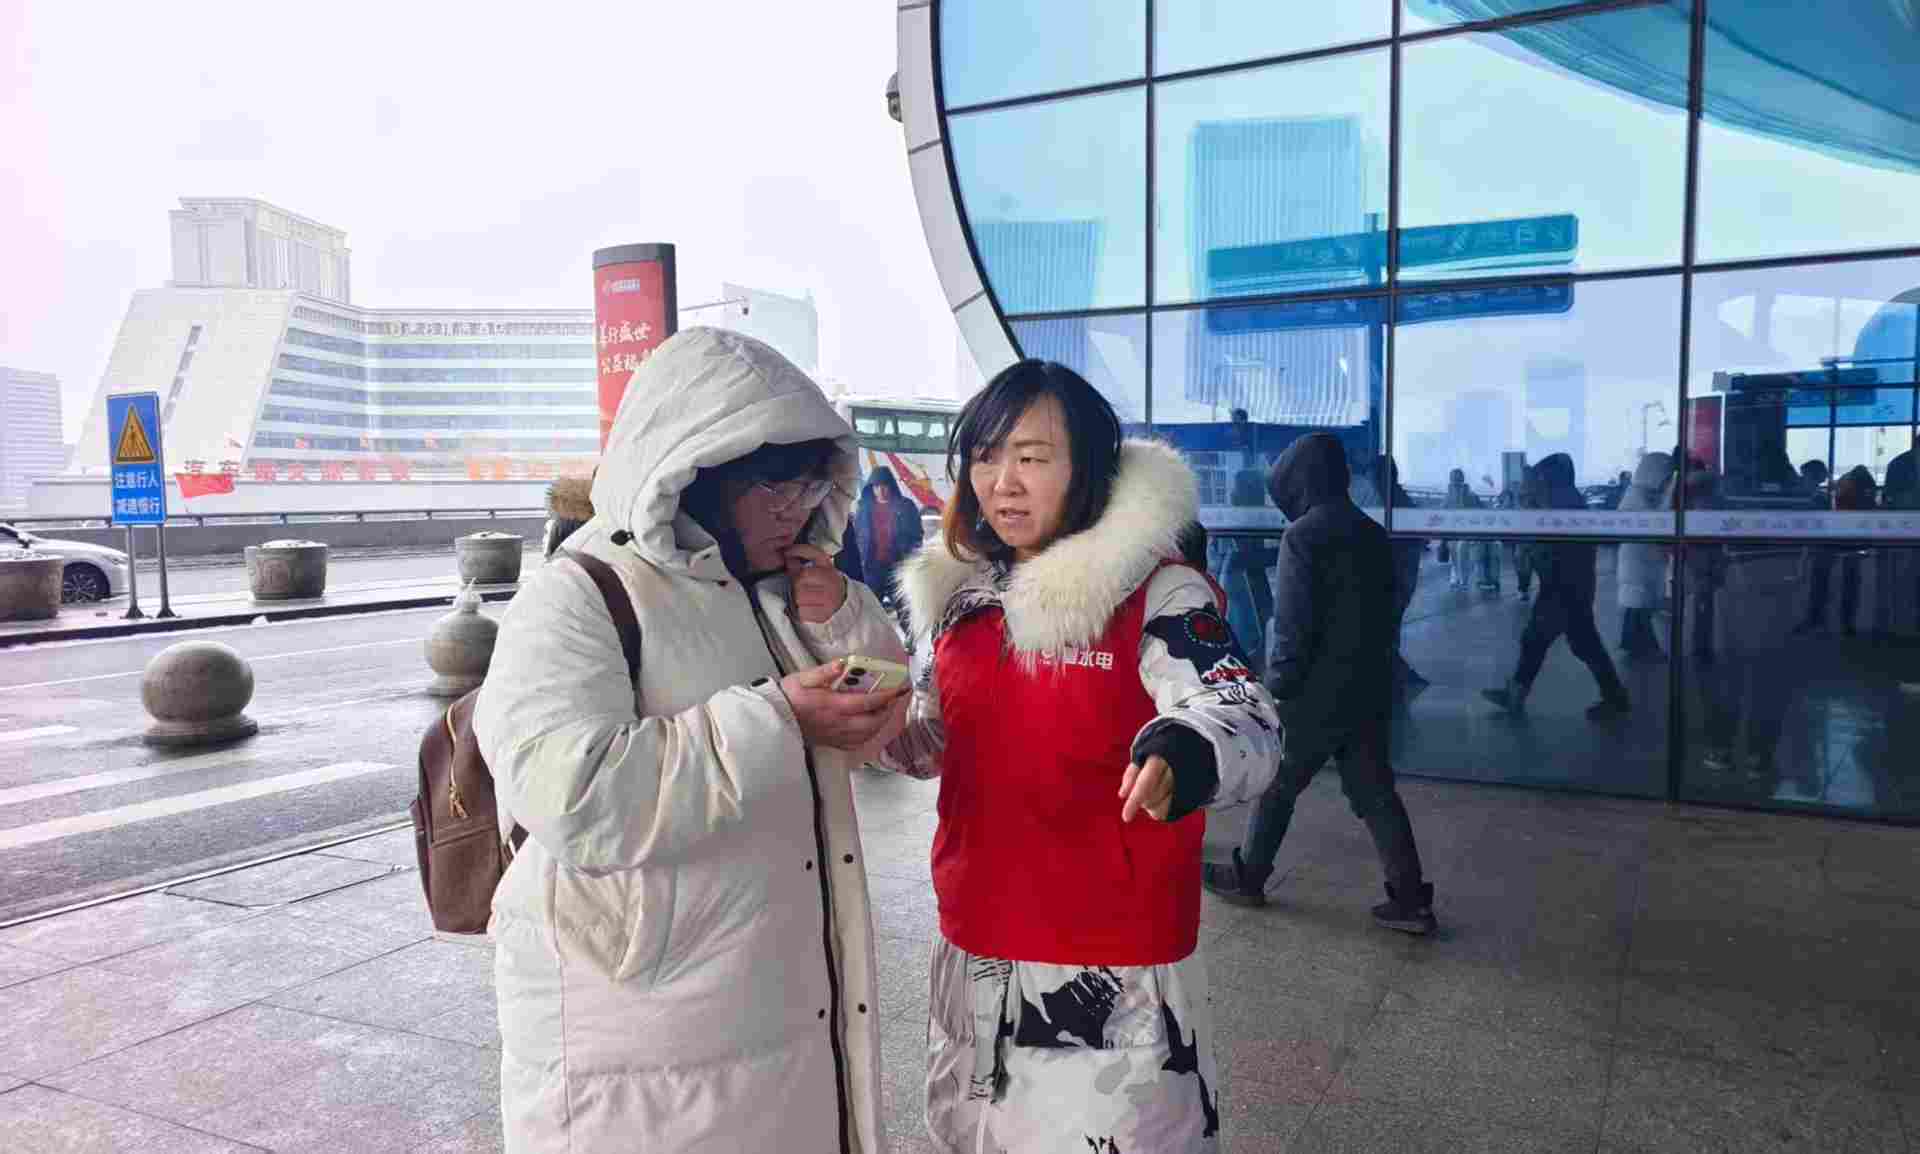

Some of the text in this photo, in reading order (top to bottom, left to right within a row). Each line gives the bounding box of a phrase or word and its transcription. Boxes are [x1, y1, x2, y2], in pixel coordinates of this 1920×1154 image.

[114, 471, 160, 488] 注意行人
[114, 497, 161, 514] 减速慢行
